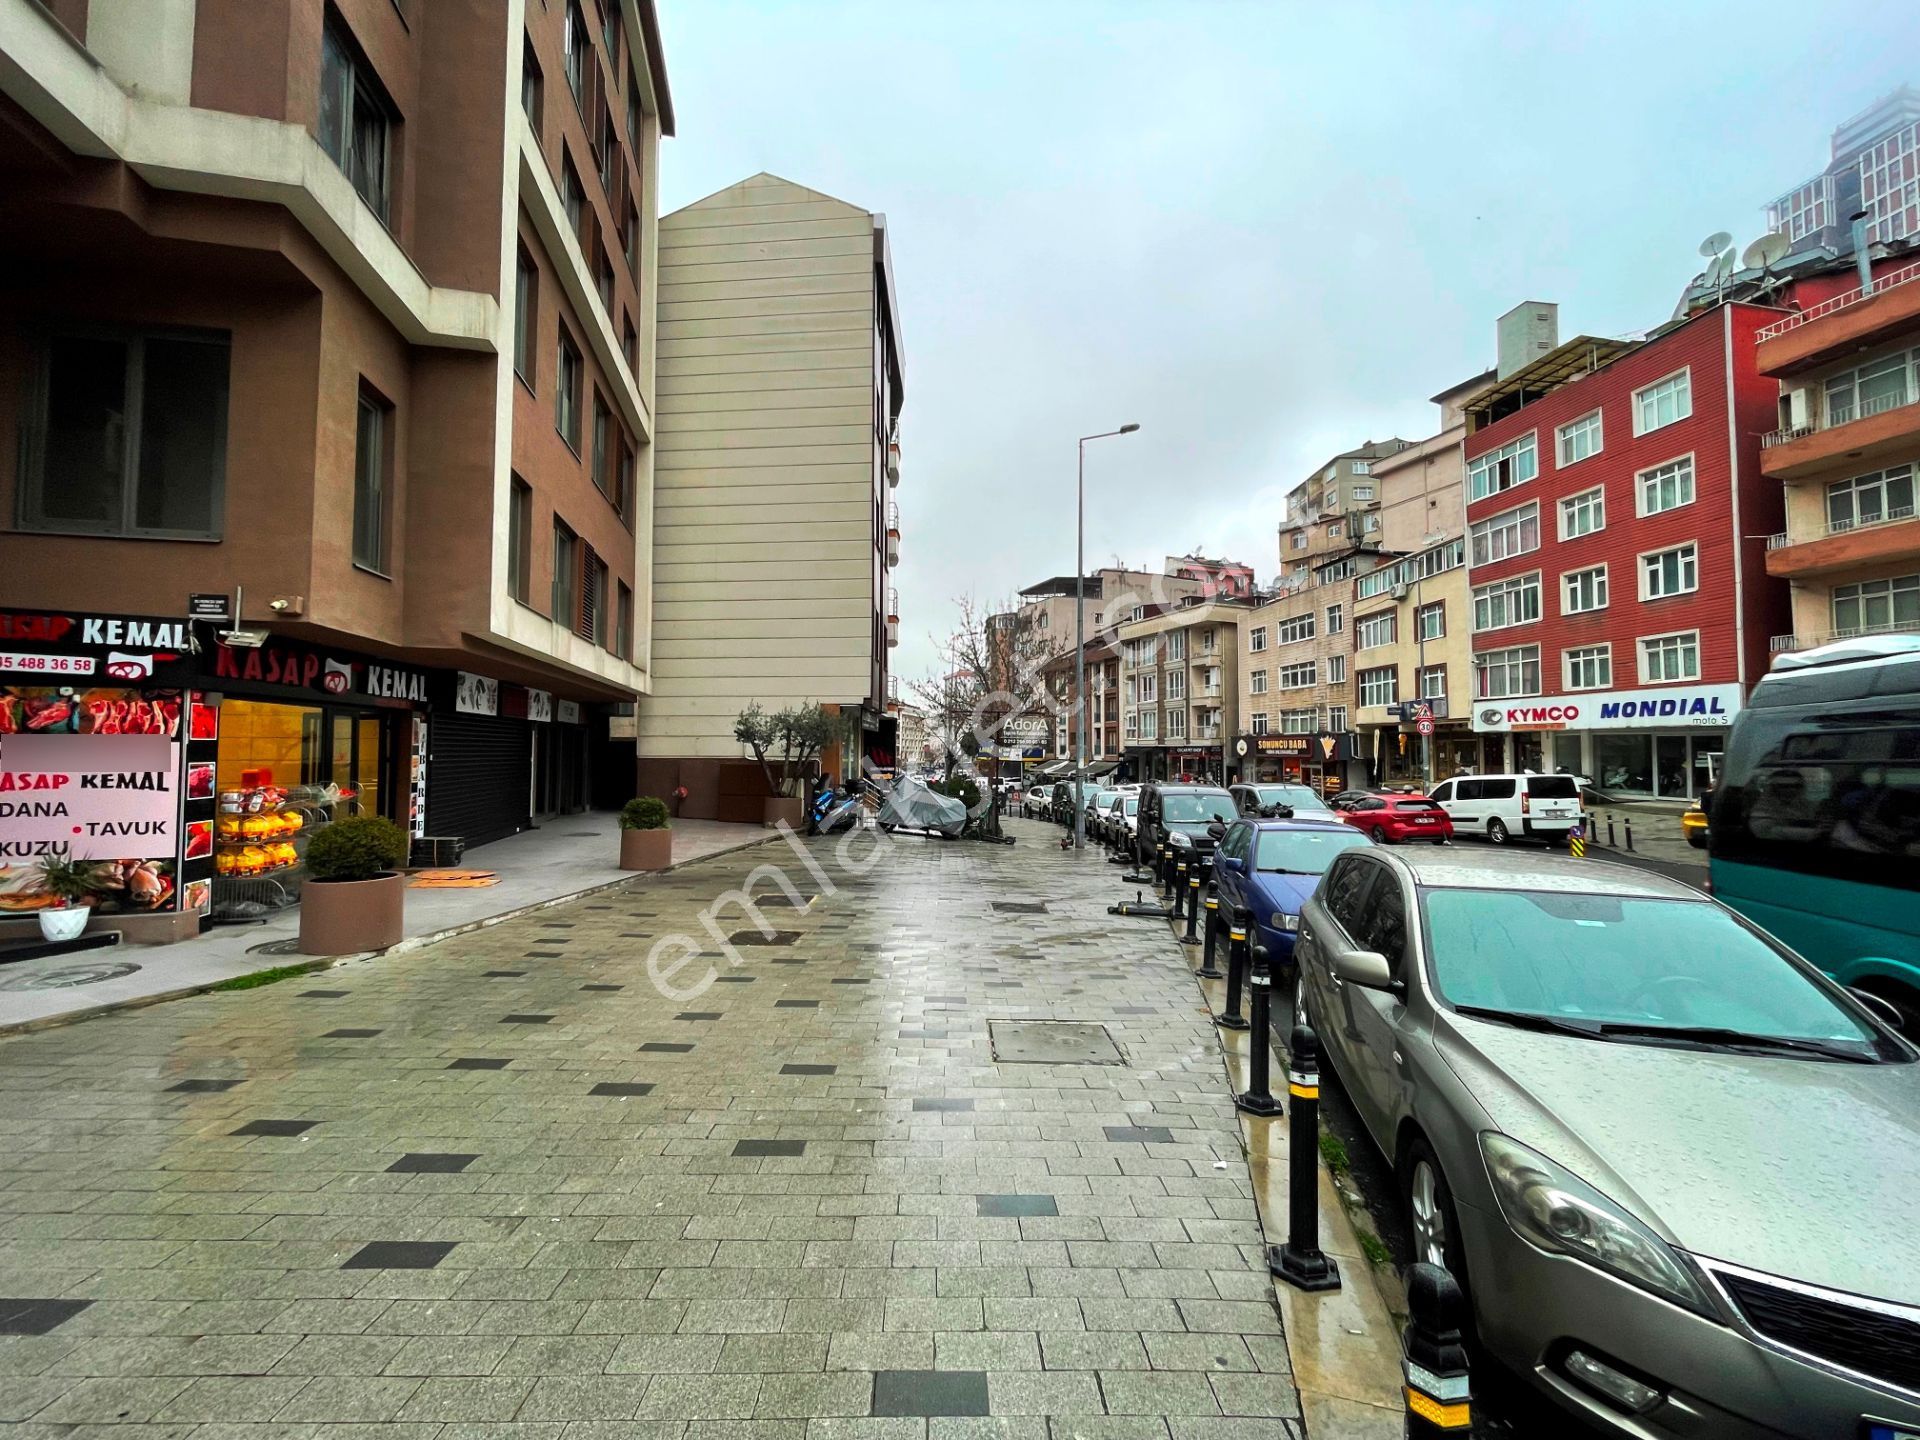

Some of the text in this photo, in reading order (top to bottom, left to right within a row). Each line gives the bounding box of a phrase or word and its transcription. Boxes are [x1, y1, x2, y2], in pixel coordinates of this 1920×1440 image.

[82, 618, 189, 649] KEMAL
[18, 657, 45, 669] 488
[50, 658, 69, 670] 36
[74, 659, 91, 671] 58
[216, 647, 428, 702] KASAP KEMAL
[1507, 705, 1579, 722] KYMCO
[1600, 696, 1726, 719] MONDIAL
[1003, 718, 1048, 731] AdorA
[1692, 716, 1717, 725] moto
[1258, 739, 1307, 749] SOMUNCU BABA
[80, 772, 170, 792] KEMAL
[0, 801, 69, 818] DANA
[86, 820, 167, 836] TAVUK
[0, 840, 69, 857] KUZU
